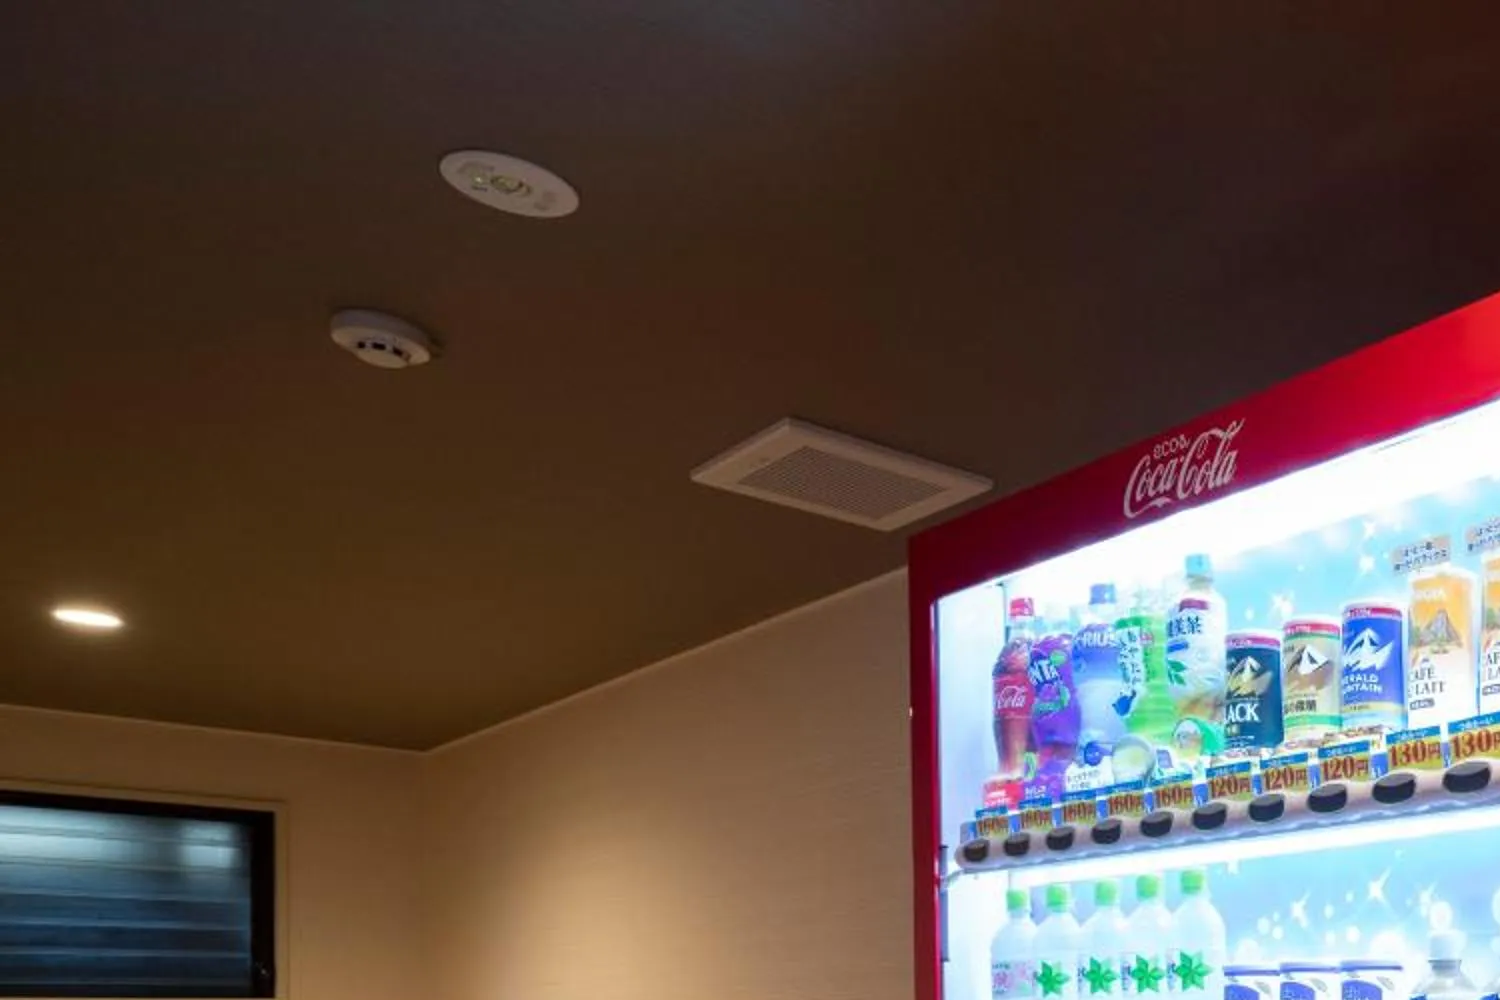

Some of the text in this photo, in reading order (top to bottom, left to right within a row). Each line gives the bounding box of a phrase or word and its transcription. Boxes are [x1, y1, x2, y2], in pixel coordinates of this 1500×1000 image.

[1124, 418, 1246, 518] Coca-Cola
[1389, 740, 1441, 767] 130円
[1264, 765, 1307, 790] 120円
[1322, 755, 1369, 782] 120円
[1208, 775, 1250, 800] 120円
